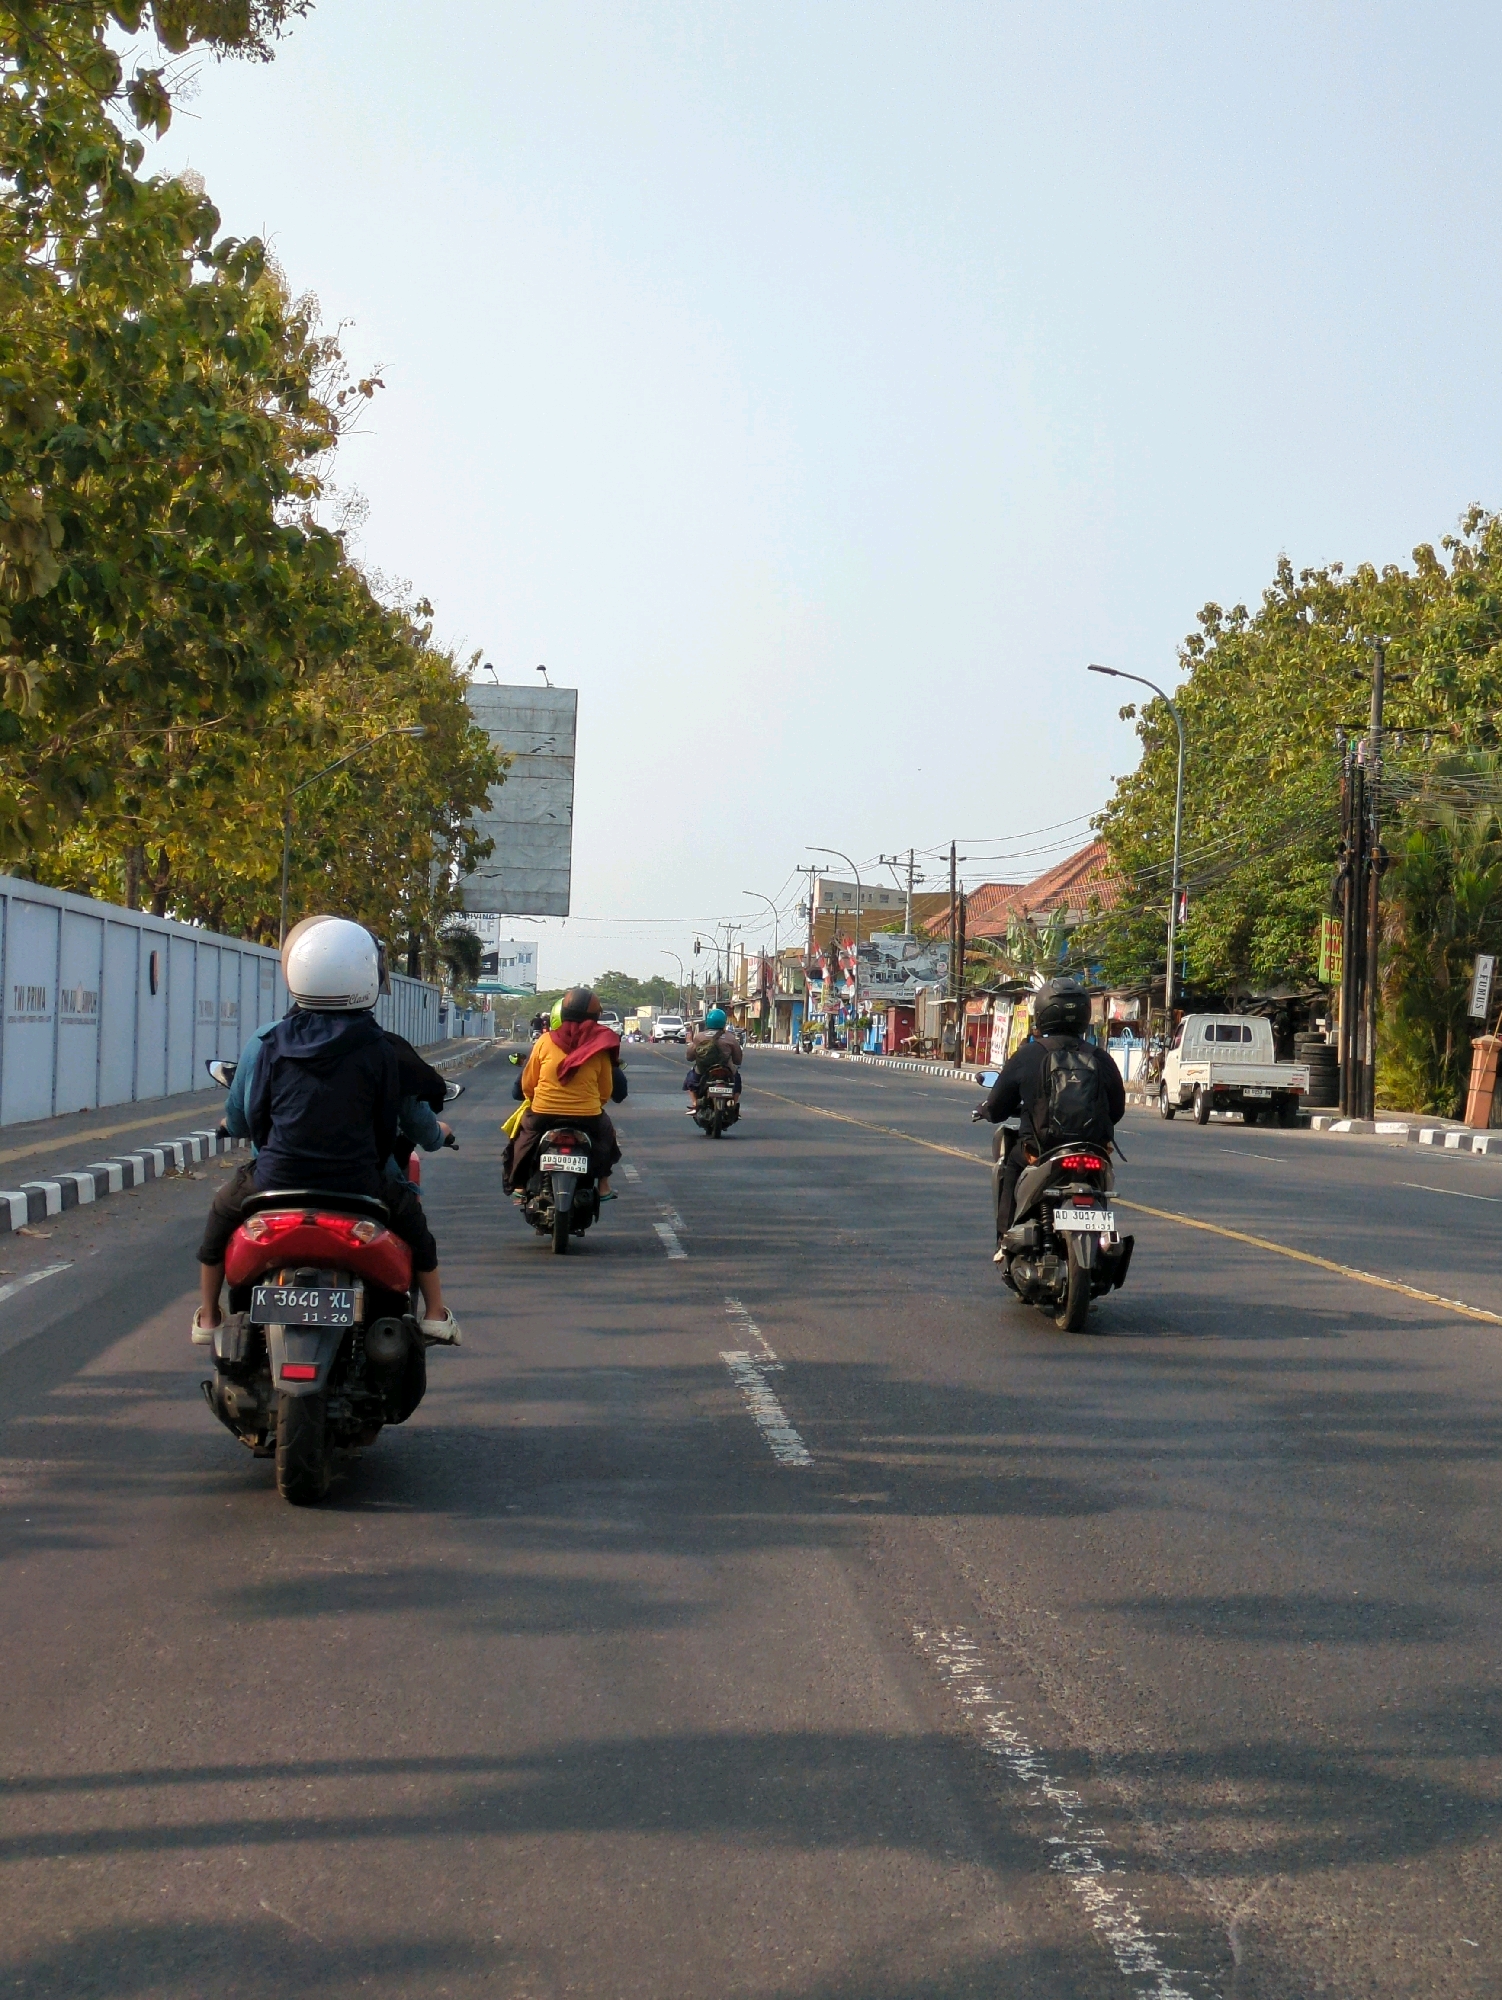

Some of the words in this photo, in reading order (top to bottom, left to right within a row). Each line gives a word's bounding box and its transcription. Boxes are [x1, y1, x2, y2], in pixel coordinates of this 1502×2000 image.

[1475, 973, 1489, 1010] FUMUS
[1055, 1210, 1068, 1219] AD
[256, 1290, 266, 1306] K
[277, 1291, 319, 1307] 3640
[331, 1292, 351, 1308] XL
